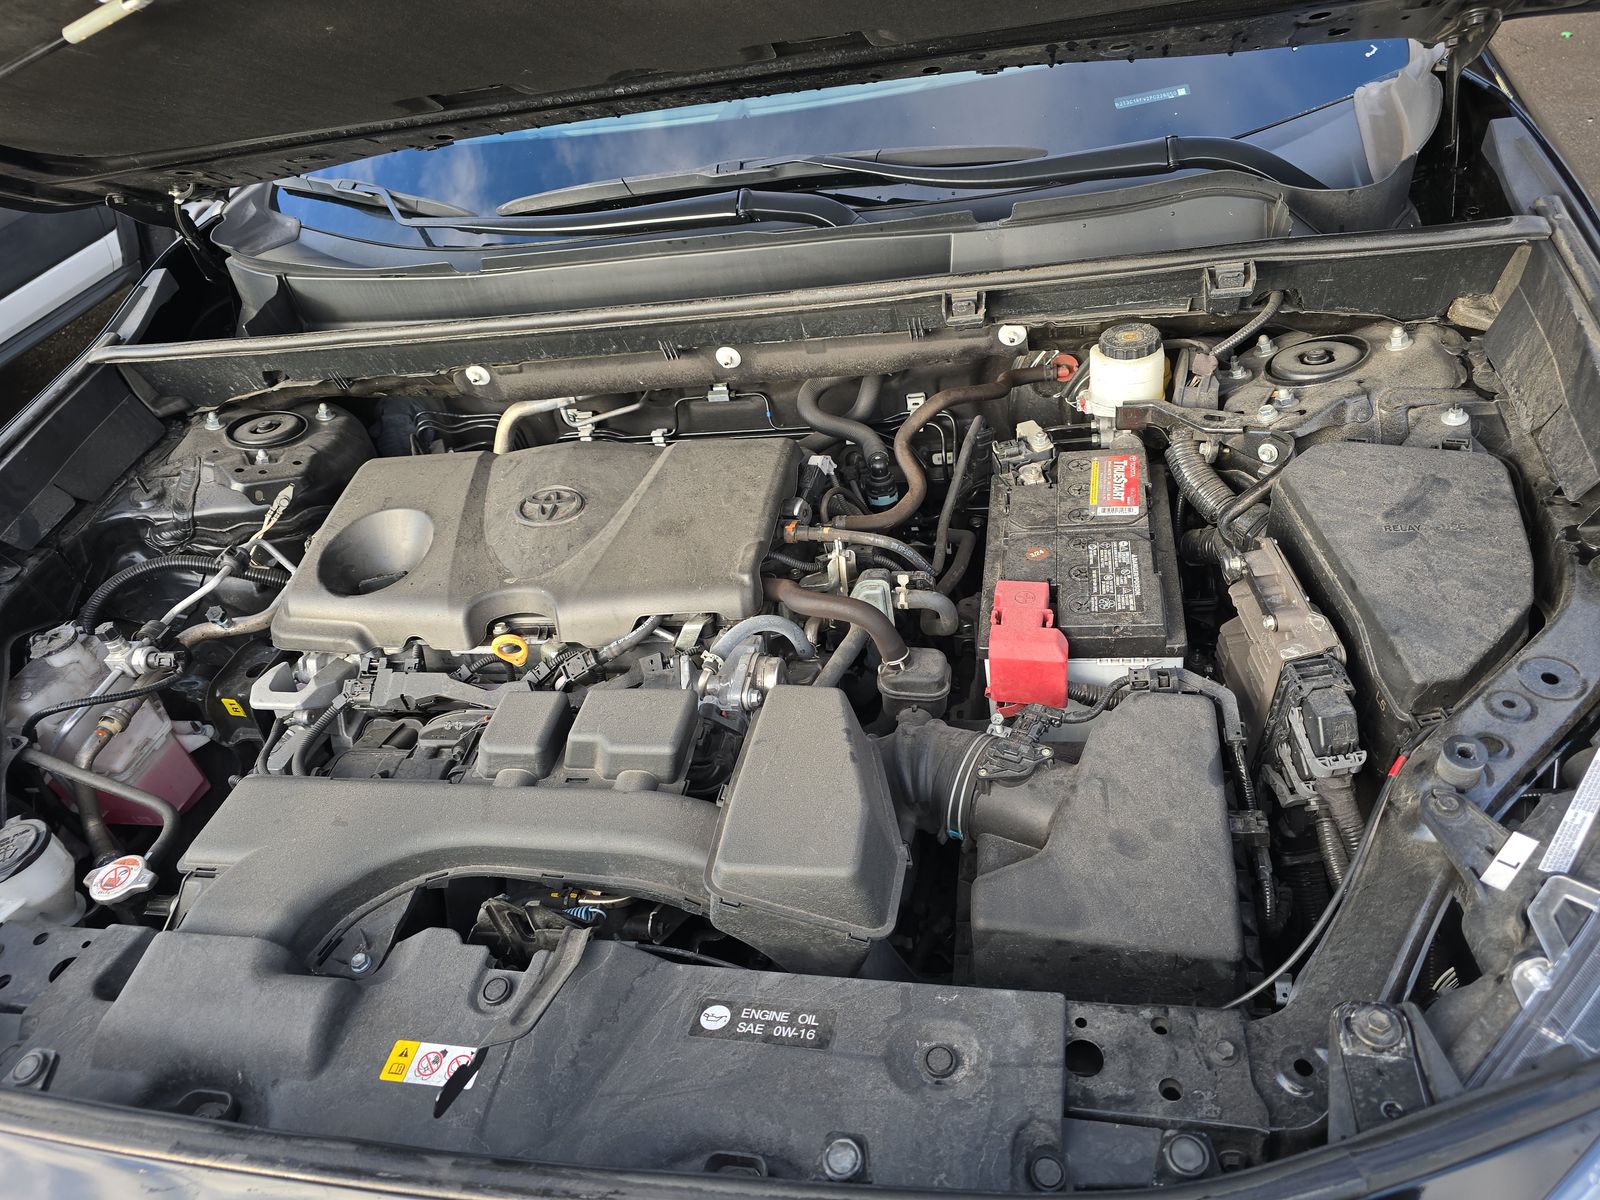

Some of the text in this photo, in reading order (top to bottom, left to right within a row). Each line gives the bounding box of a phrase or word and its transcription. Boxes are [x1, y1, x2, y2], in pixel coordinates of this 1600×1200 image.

[1384, 524, 1421, 532] RELAY
[1497, 859, 1521, 869] L
[741, 1008, 819, 1026] ENGINE OIL
[736, 1021, 816, 1040] SAE 0W-16
